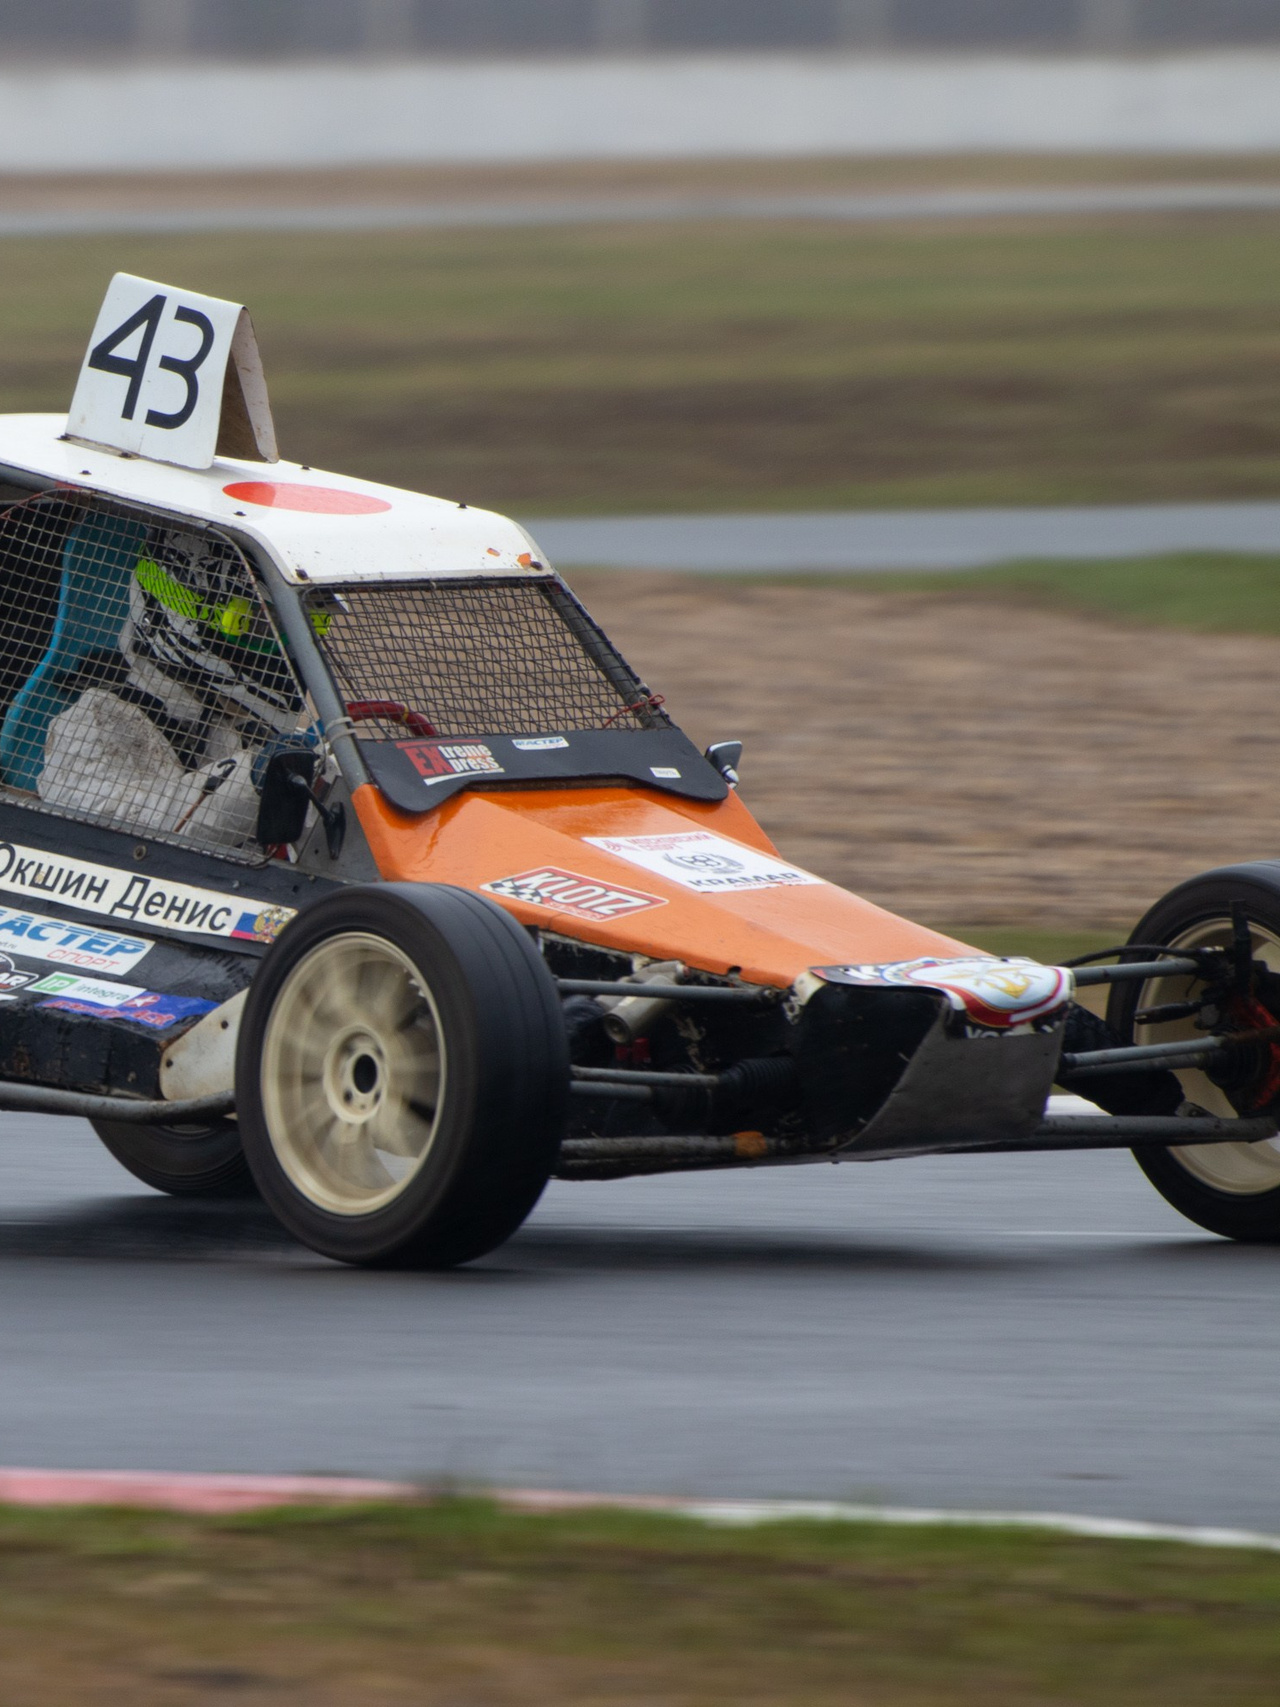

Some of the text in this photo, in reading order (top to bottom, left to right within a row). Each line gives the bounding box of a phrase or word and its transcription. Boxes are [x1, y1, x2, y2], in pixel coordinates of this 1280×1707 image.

[88, 294, 215, 430] 43
[448, 756, 500, 773] press
[686, 871, 801, 888] KRAMAR
[108, 875, 233, 932] Денис
[516, 871, 652, 916] KLOTZ
[46, 948, 121, 970] СПОРТ
[41, 978, 131, 1001] IP integra
